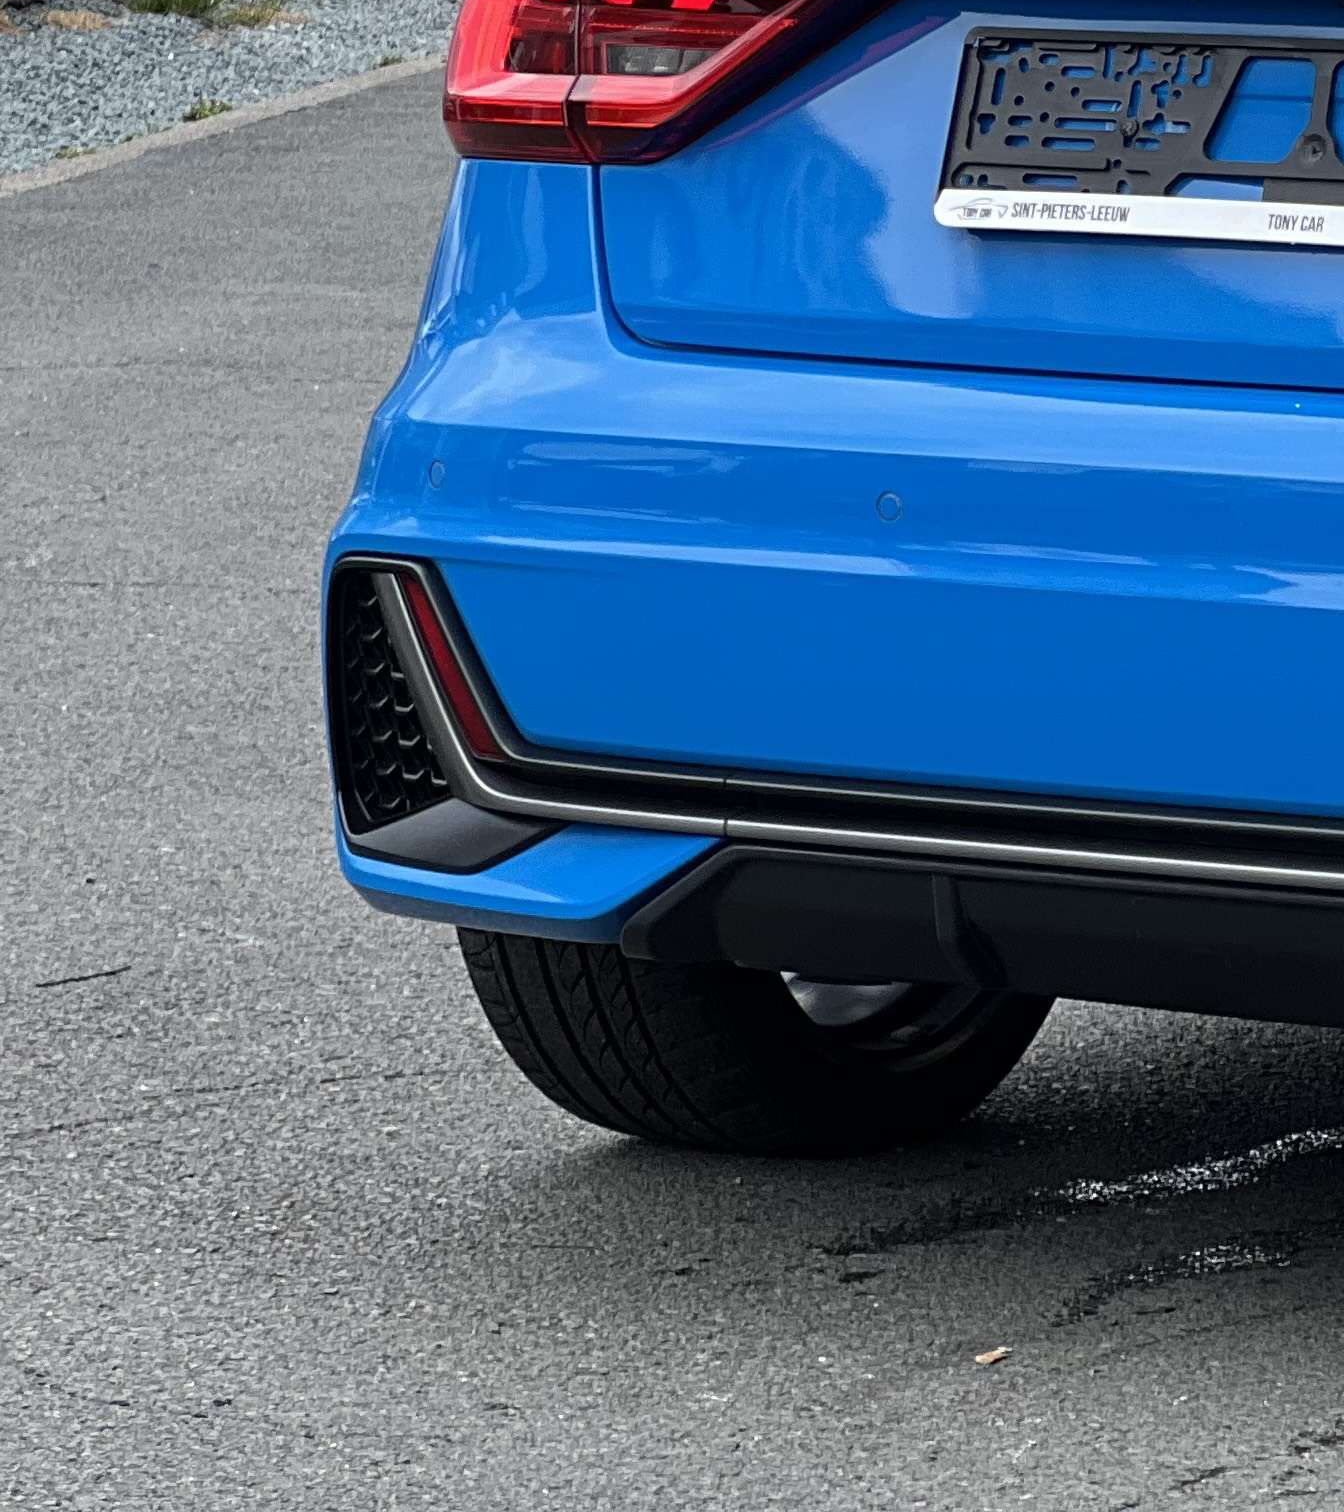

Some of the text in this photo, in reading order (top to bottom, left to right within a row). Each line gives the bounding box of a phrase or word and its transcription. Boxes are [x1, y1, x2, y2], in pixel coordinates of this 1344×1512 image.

[1011, 202, 1131, 222] SINT-PIETERS-LEEUW
[1268, 214, 1326, 233] TONY CAR
